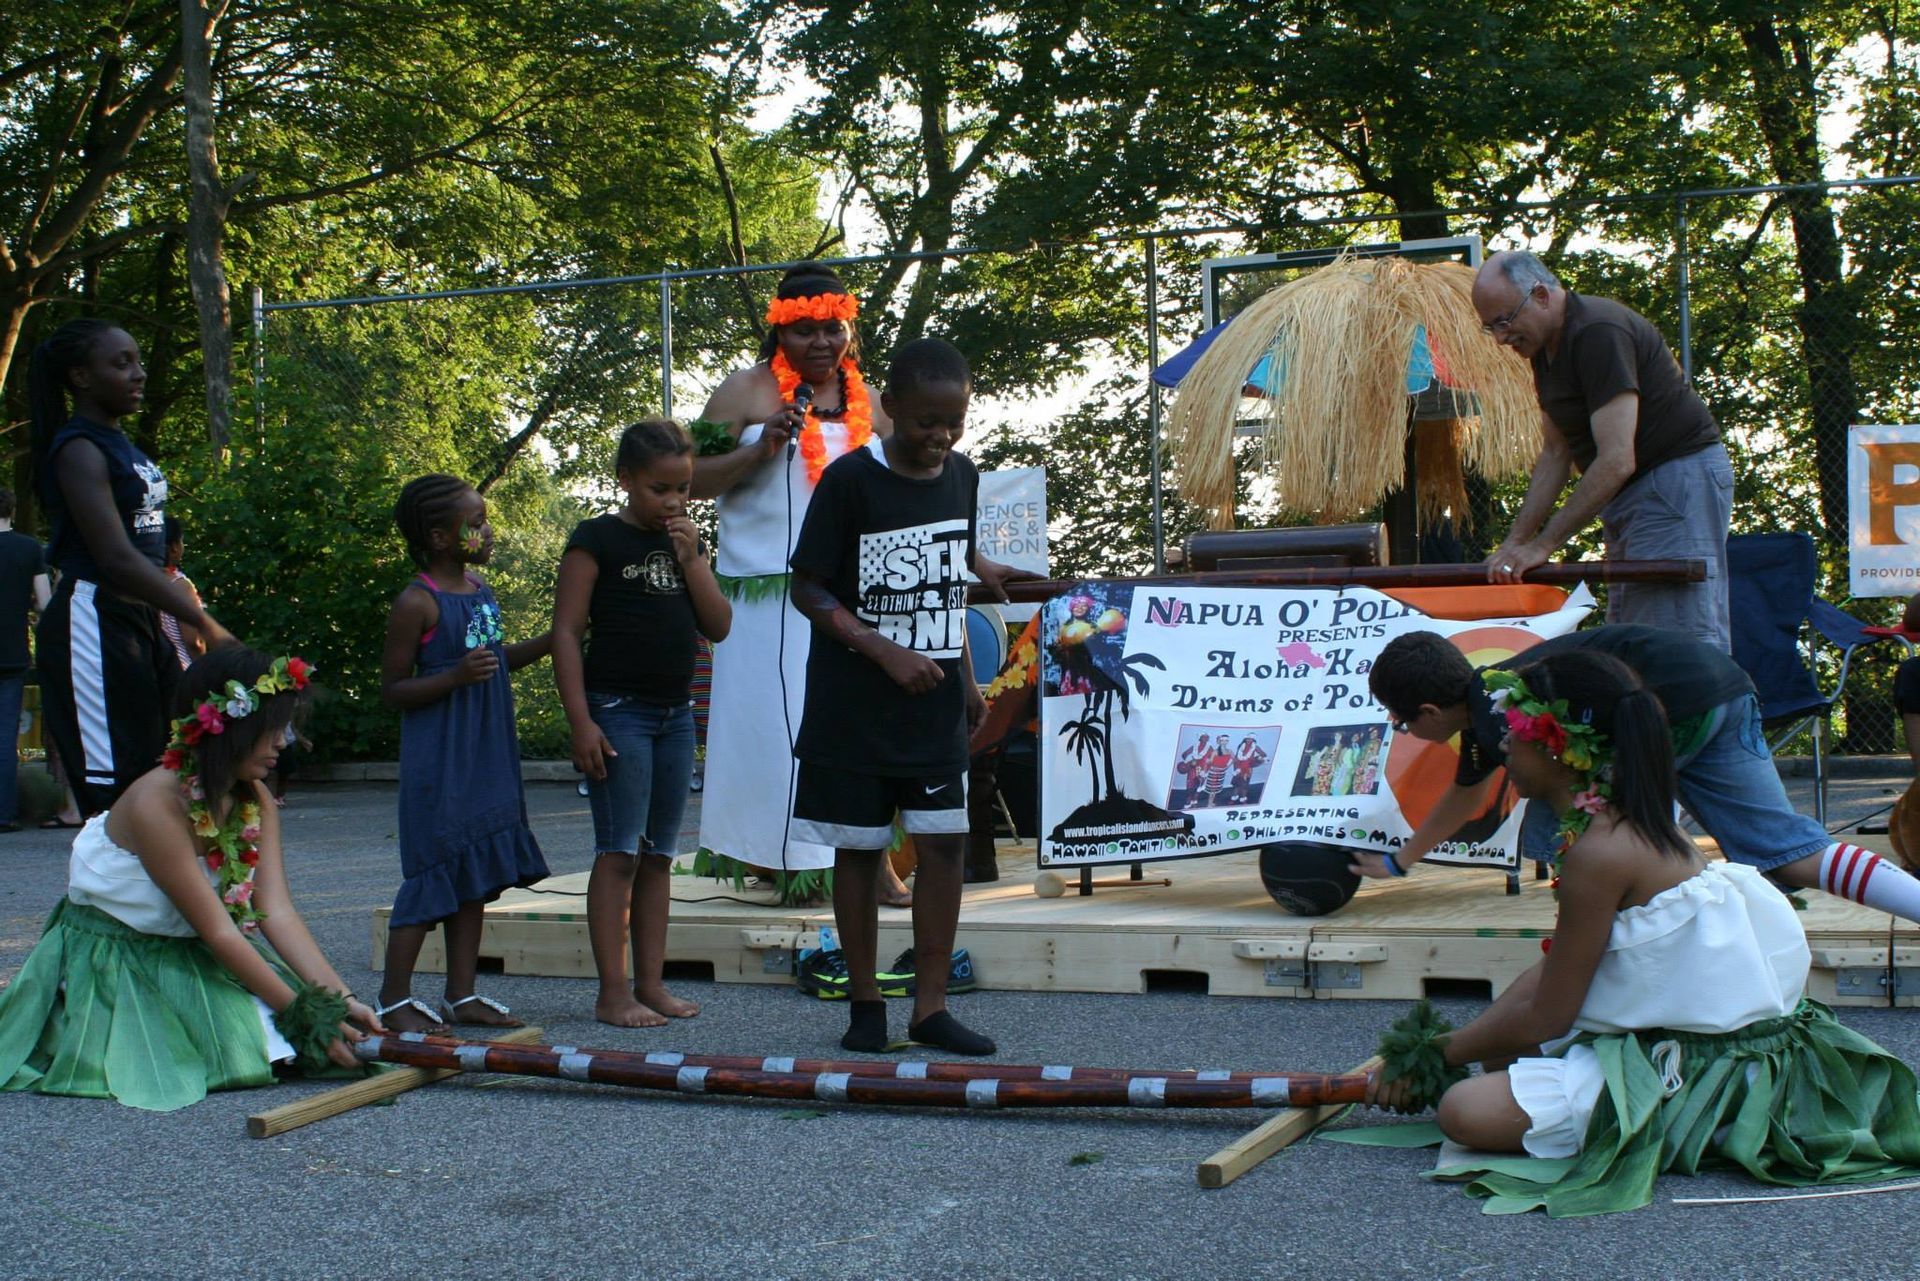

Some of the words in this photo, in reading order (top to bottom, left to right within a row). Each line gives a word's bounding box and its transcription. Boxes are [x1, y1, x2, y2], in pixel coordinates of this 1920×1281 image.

[979, 520, 1019, 538] RKS
[1026, 520, 1039, 535] &
[979, 538, 1039, 556] ATION
[866, 592, 922, 612] CLOTHING
[1145, 596, 1264, 626] NAPUA
[1279, 599, 1319, 627] O'
[1278, 623, 1386, 643] PRESENTS
[1205, 650, 1310, 679] Aloha
[1325, 648, 1372, 676] Ha
[1171, 684, 1274, 713] Drums
[1284, 694, 1313, 711] of
[1323, 684, 1387, 712] Pol
[1226, 807, 1359, 822] REPRESENTING
[1052, 843, 1104, 859] HAWAII
[1119, 838, 1163, 855] TAHITI
[1176, 833, 1221, 850] MAORI
[1243, 825, 1347, 841] PHILIPPINES
